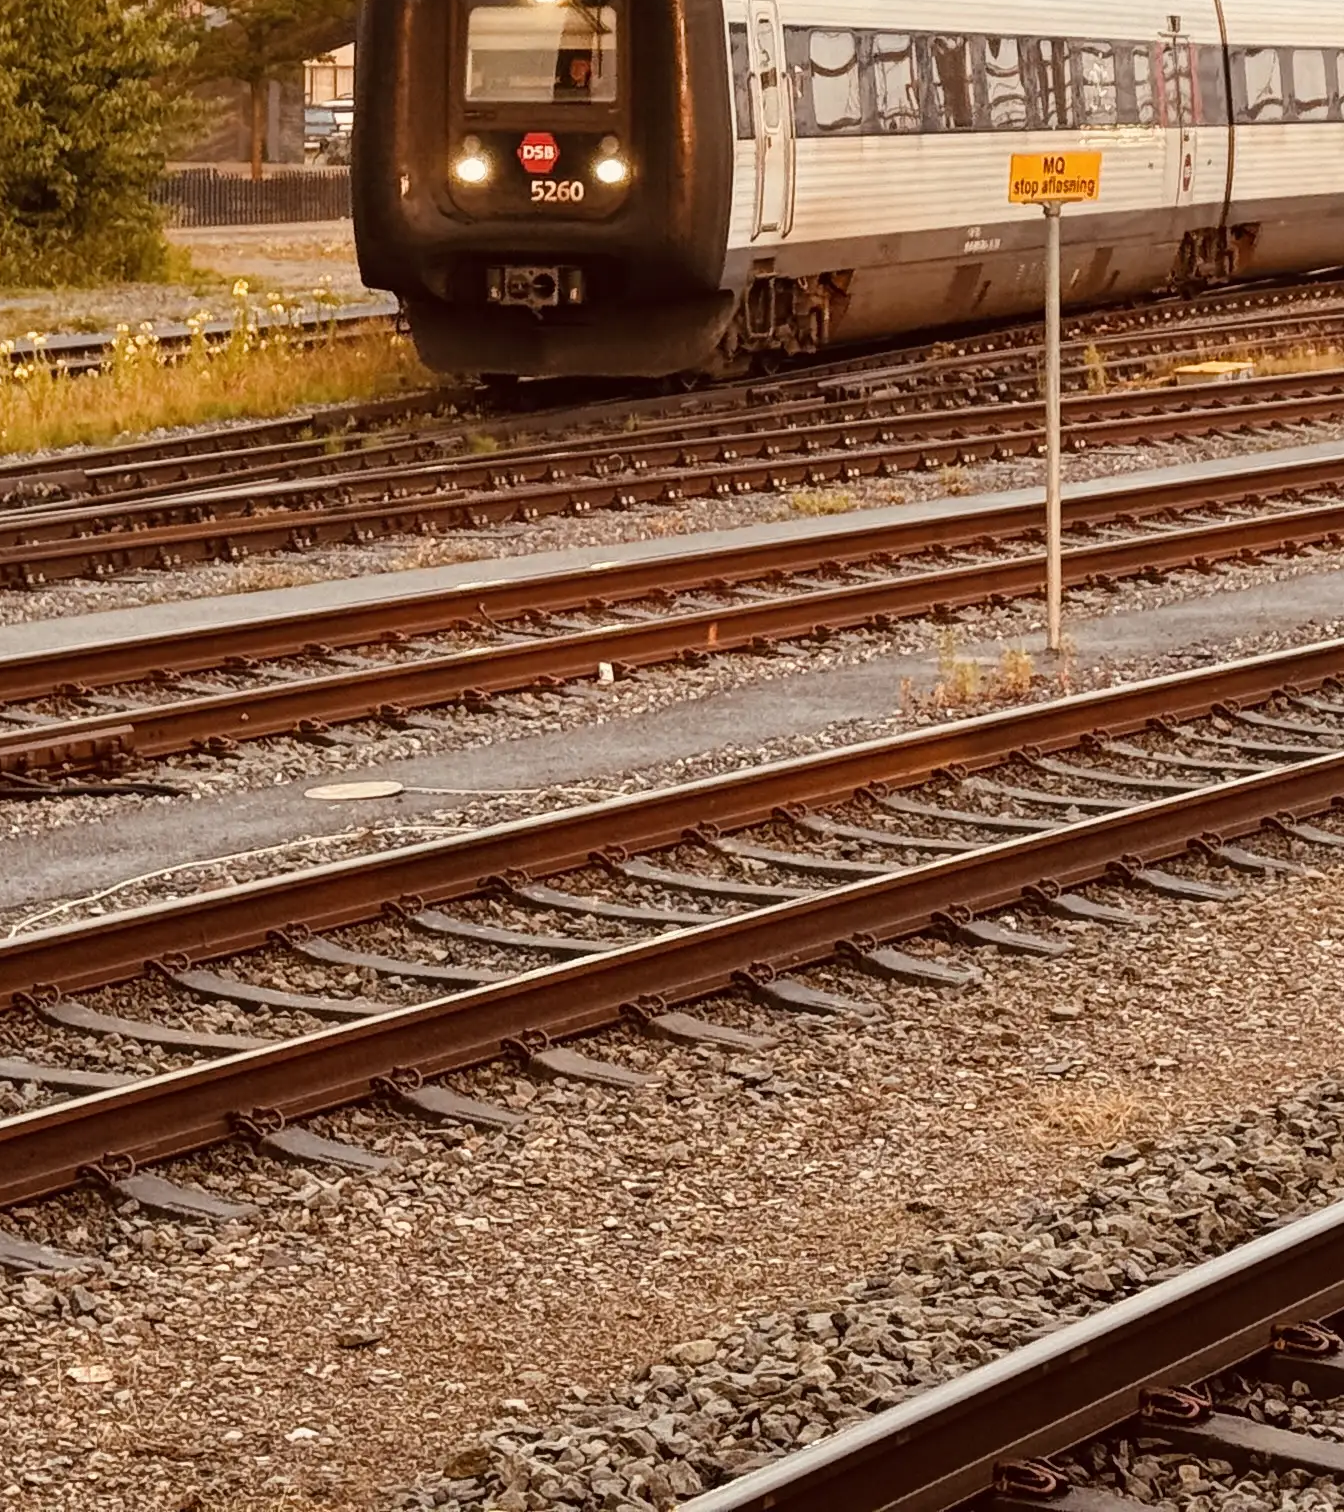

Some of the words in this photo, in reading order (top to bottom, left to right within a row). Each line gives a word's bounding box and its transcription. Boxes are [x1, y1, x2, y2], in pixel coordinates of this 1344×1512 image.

[522, 145, 555, 160] DSB
[1043, 156, 1065, 175] MQ
[530, 180, 584, 202] 5260
[1013, 178, 1038, 198] stop
